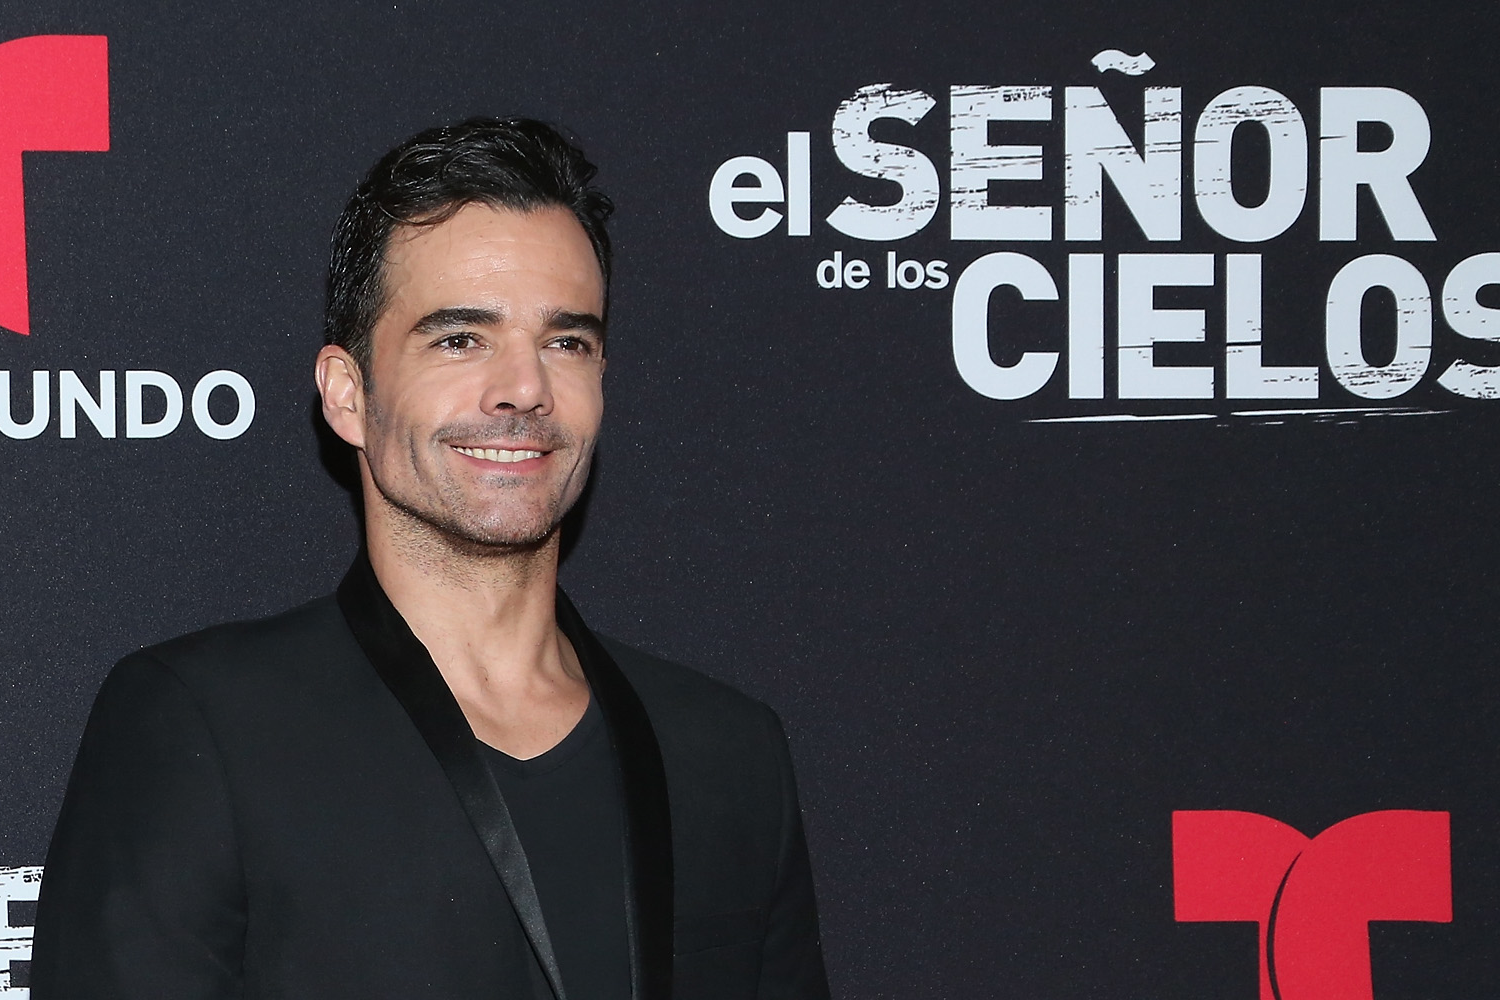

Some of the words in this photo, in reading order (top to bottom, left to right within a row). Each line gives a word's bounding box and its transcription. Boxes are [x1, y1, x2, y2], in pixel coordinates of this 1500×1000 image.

[709, 132, 810, 240] el
[822, 50, 1437, 242] SEÑOR
[816, 251, 870, 289] de
[888, 251, 949, 290] los
